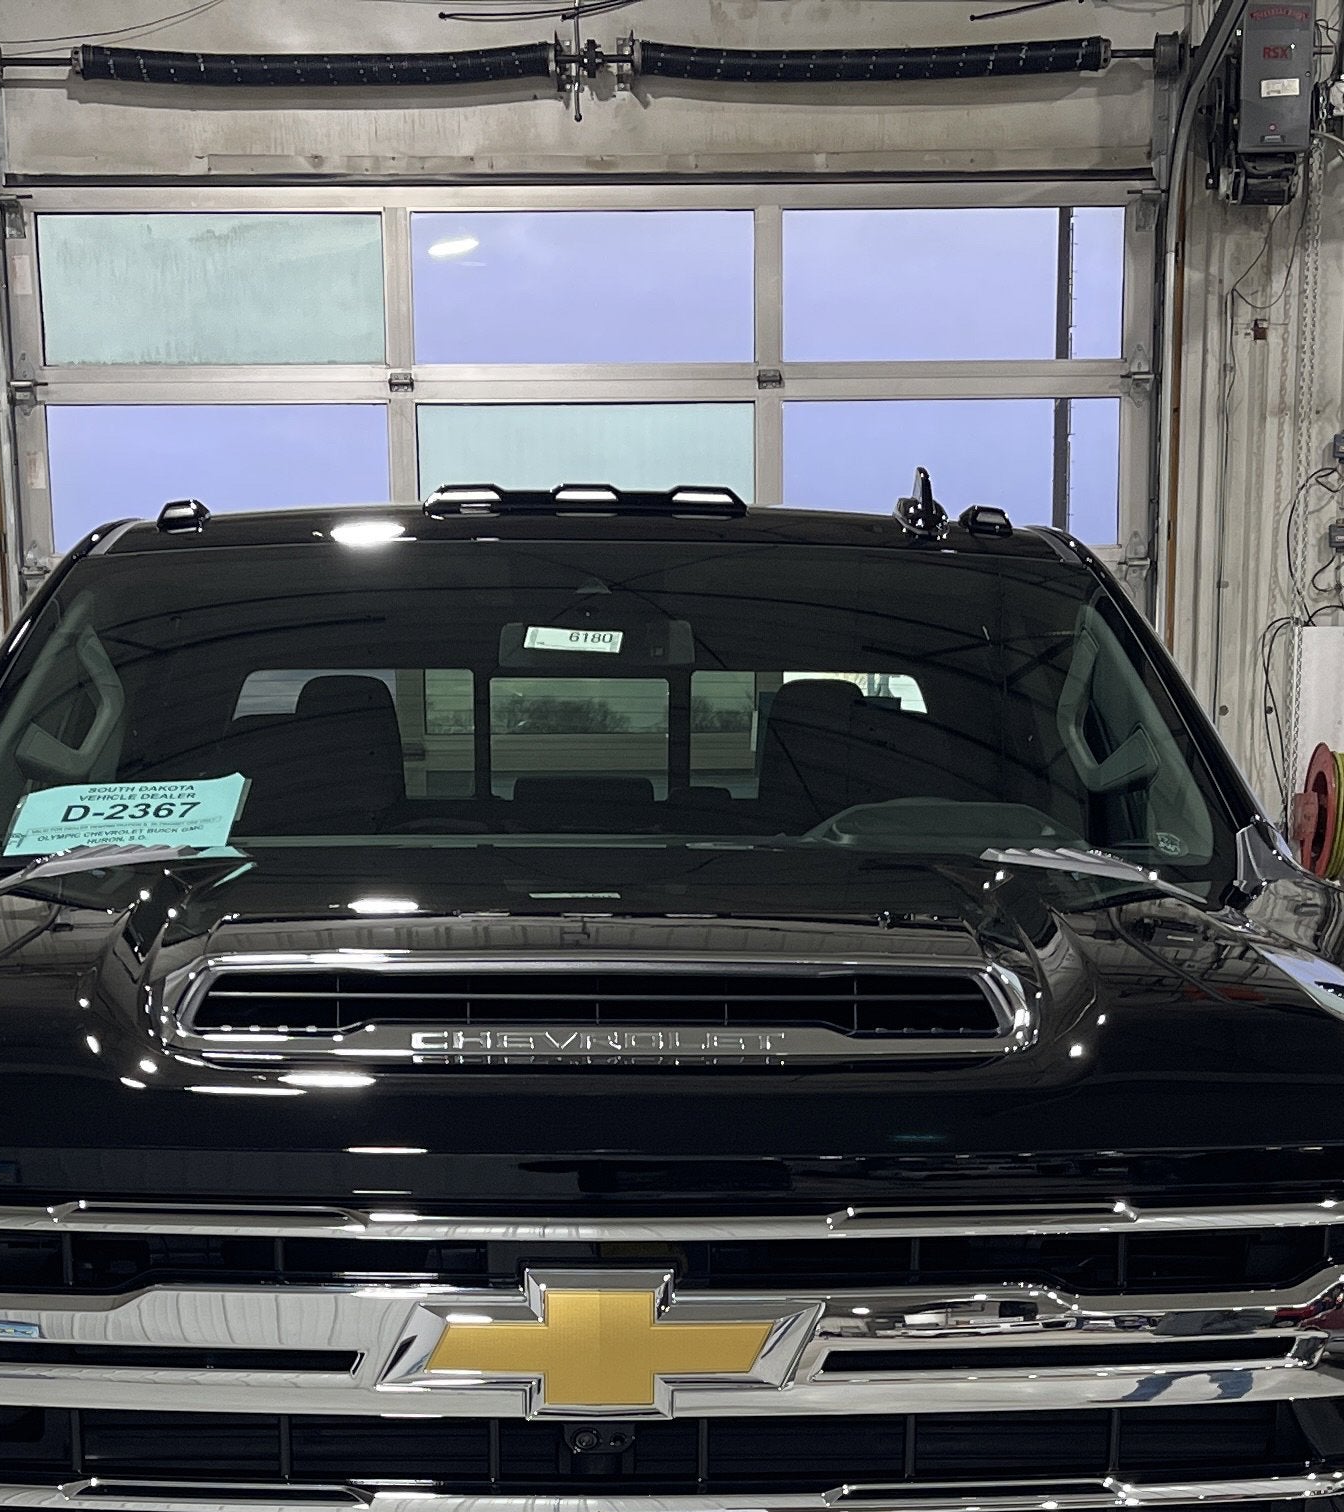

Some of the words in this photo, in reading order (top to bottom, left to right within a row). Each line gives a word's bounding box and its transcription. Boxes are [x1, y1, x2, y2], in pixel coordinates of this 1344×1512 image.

[569, 631, 613, 643] 6180
[88, 786, 136, 794] SOUTH
[139, 784, 195, 792] DAKOTA
[79, 794, 137, 802] VEHICLE
[140, 792, 196, 800] DEALER
[61, 801, 201, 823] D-2367
[37, 832, 80, 842] OLYMPIC
[83, 829, 143, 838] CHEVROLET
[147, 827, 178, 835] BUICK
[411, 1030, 786, 1052] CHEVROLET
